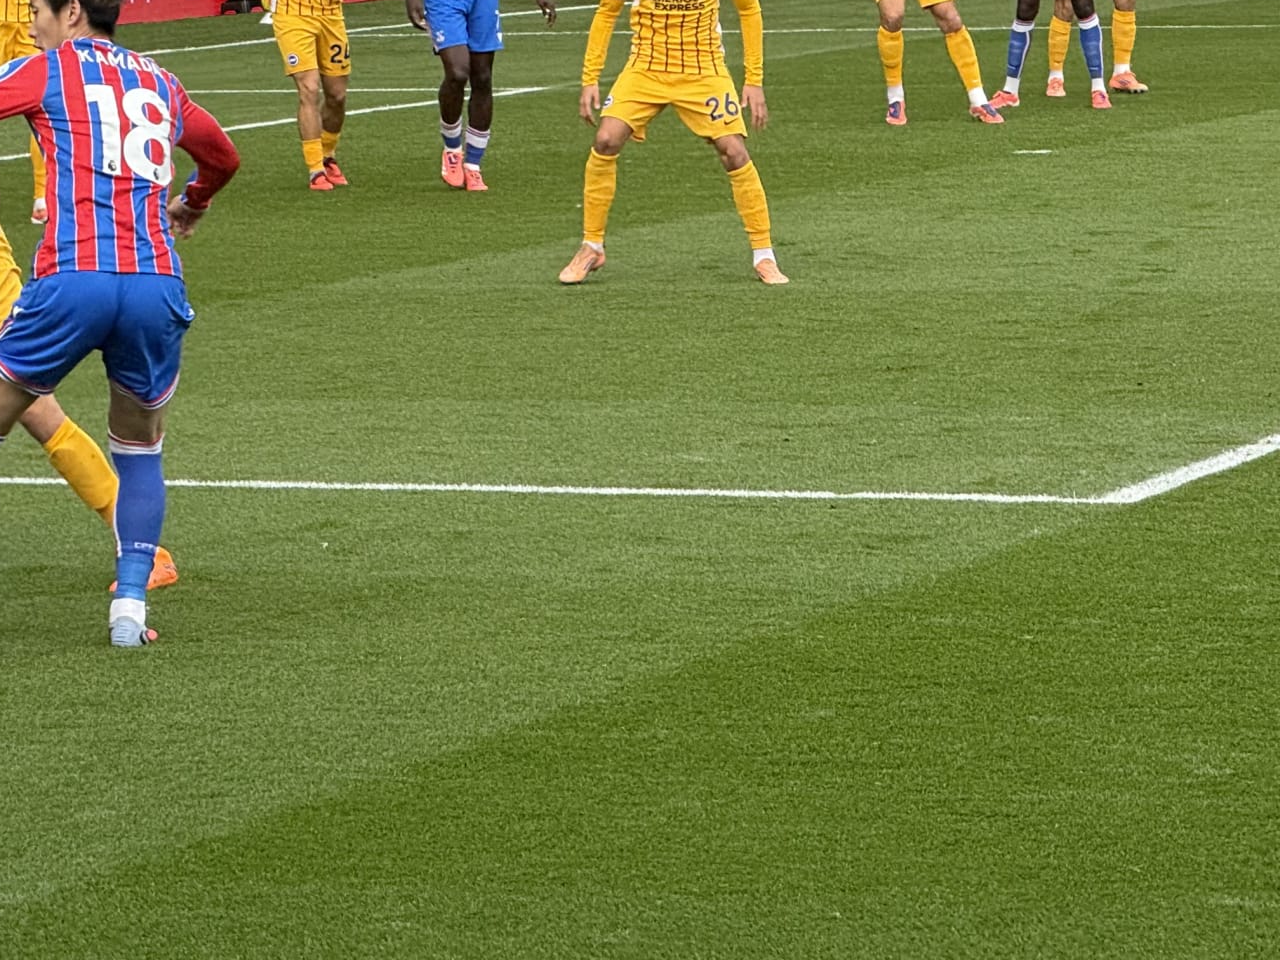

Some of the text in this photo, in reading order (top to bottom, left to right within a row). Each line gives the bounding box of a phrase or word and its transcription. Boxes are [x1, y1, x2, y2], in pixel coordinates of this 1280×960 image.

[655, 2, 705, 11] EXPRESS
[705, 92, 739, 122] 26
[83, 84, 173, 187] 18
